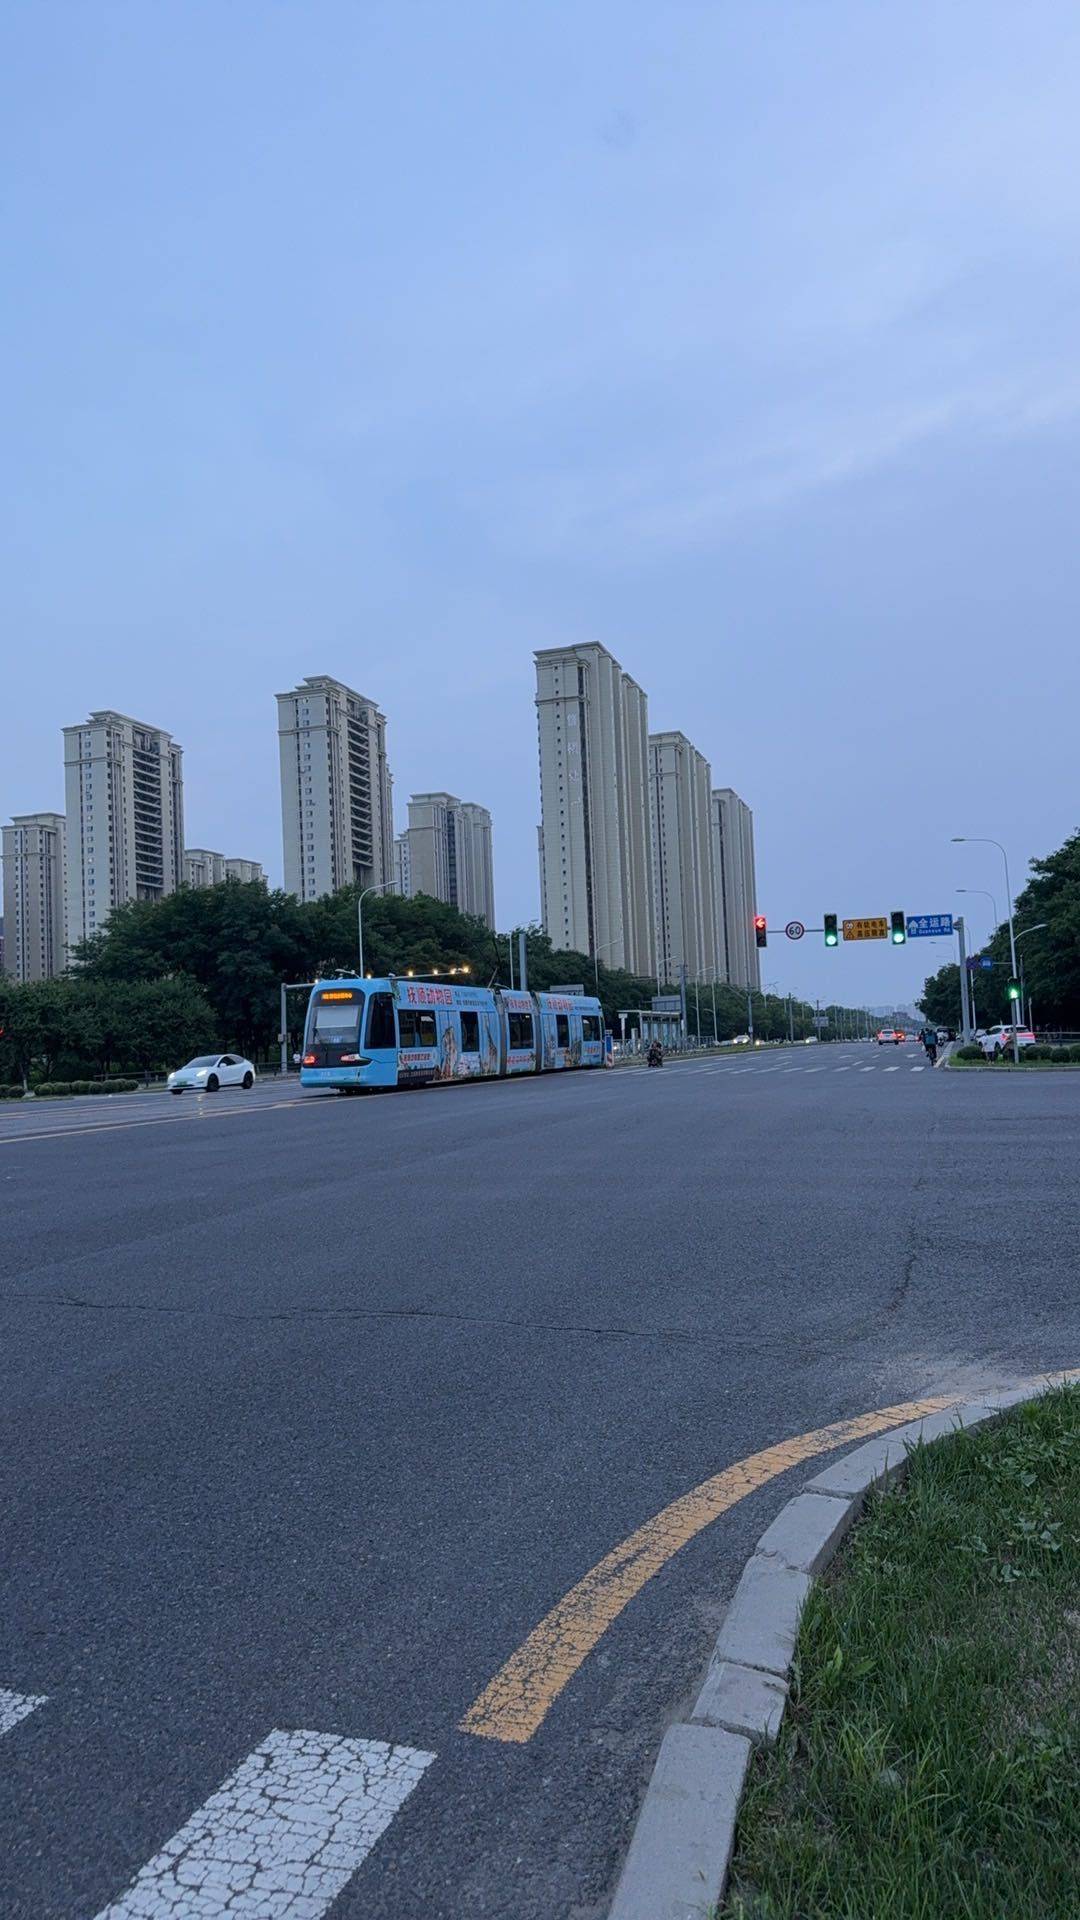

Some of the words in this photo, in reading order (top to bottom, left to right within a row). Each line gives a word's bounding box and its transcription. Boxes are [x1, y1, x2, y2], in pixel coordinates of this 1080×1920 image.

[857, 920, 884, 929] 有轨电车
[918, 916, 950, 929] 全运路
[789, 925, 801, 936] 60
[407, 986, 453, 1005] 抚顺动物园
